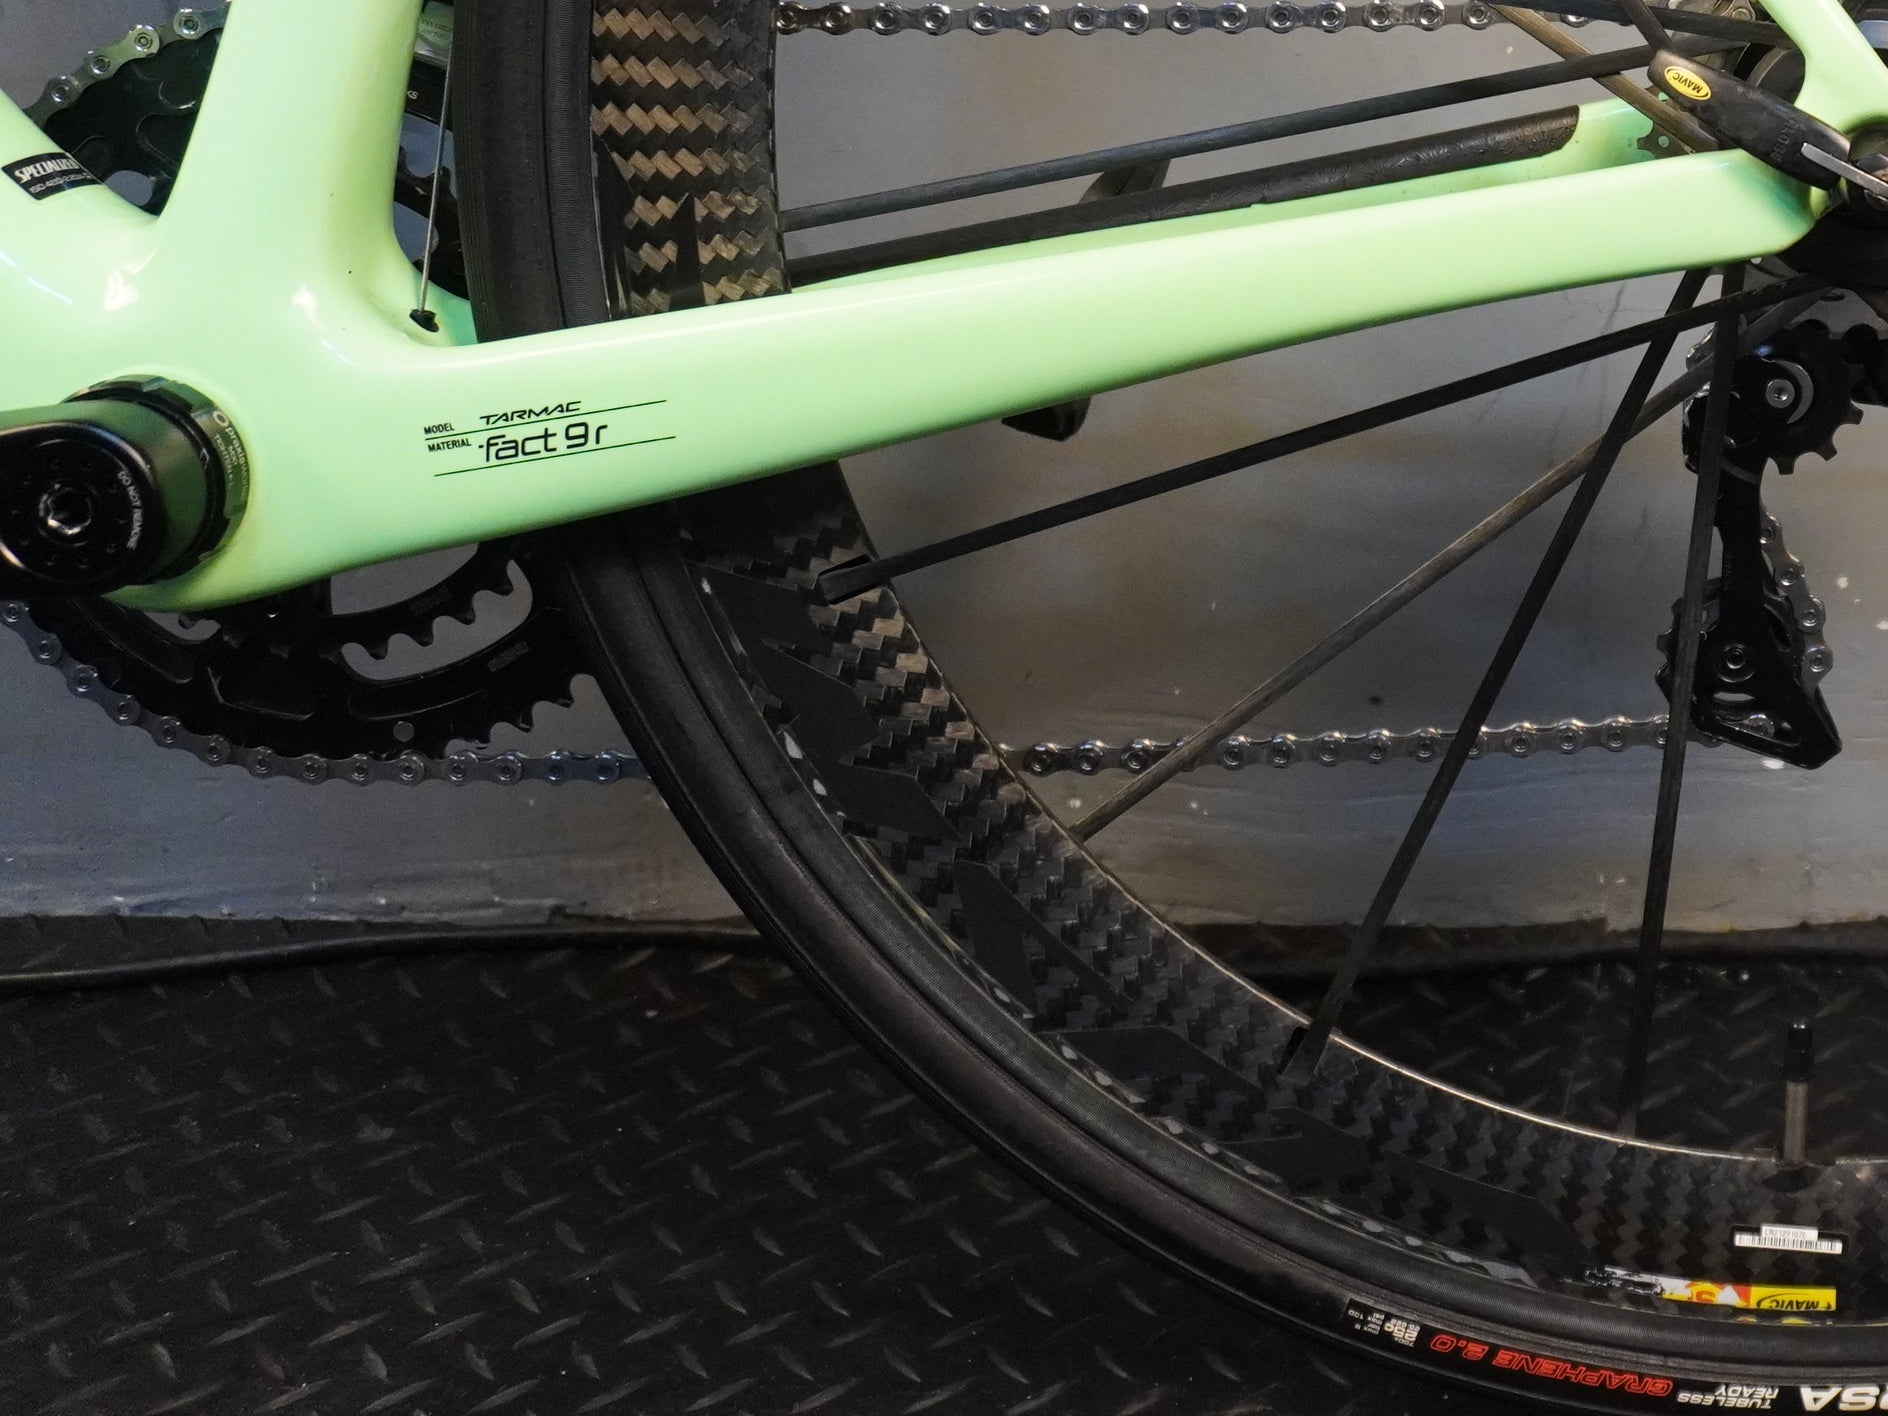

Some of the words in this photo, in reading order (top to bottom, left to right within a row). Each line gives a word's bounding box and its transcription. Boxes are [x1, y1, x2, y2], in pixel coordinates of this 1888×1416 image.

[1671, 71, 1703, 95] MAVIC
[14, 158, 80, 184] SPECIALIZED
[479, 400, 582, 426] TARMAC
[423, 422, 455, 435] MODEL
[427, 437, 472, 453] MATERIAL
[117, 470, 132, 486] DO
[126, 486, 141, 506] NOT
[1769, 1298, 1820, 1310] MAVIC
[1429, 1333, 1490, 1361] 2.0
[1491, 1349, 1674, 1397] GRAPHENE
[1676, 1392, 1772, 1410] TUBELESS
[1714, 1384, 1780, 1400] READY
